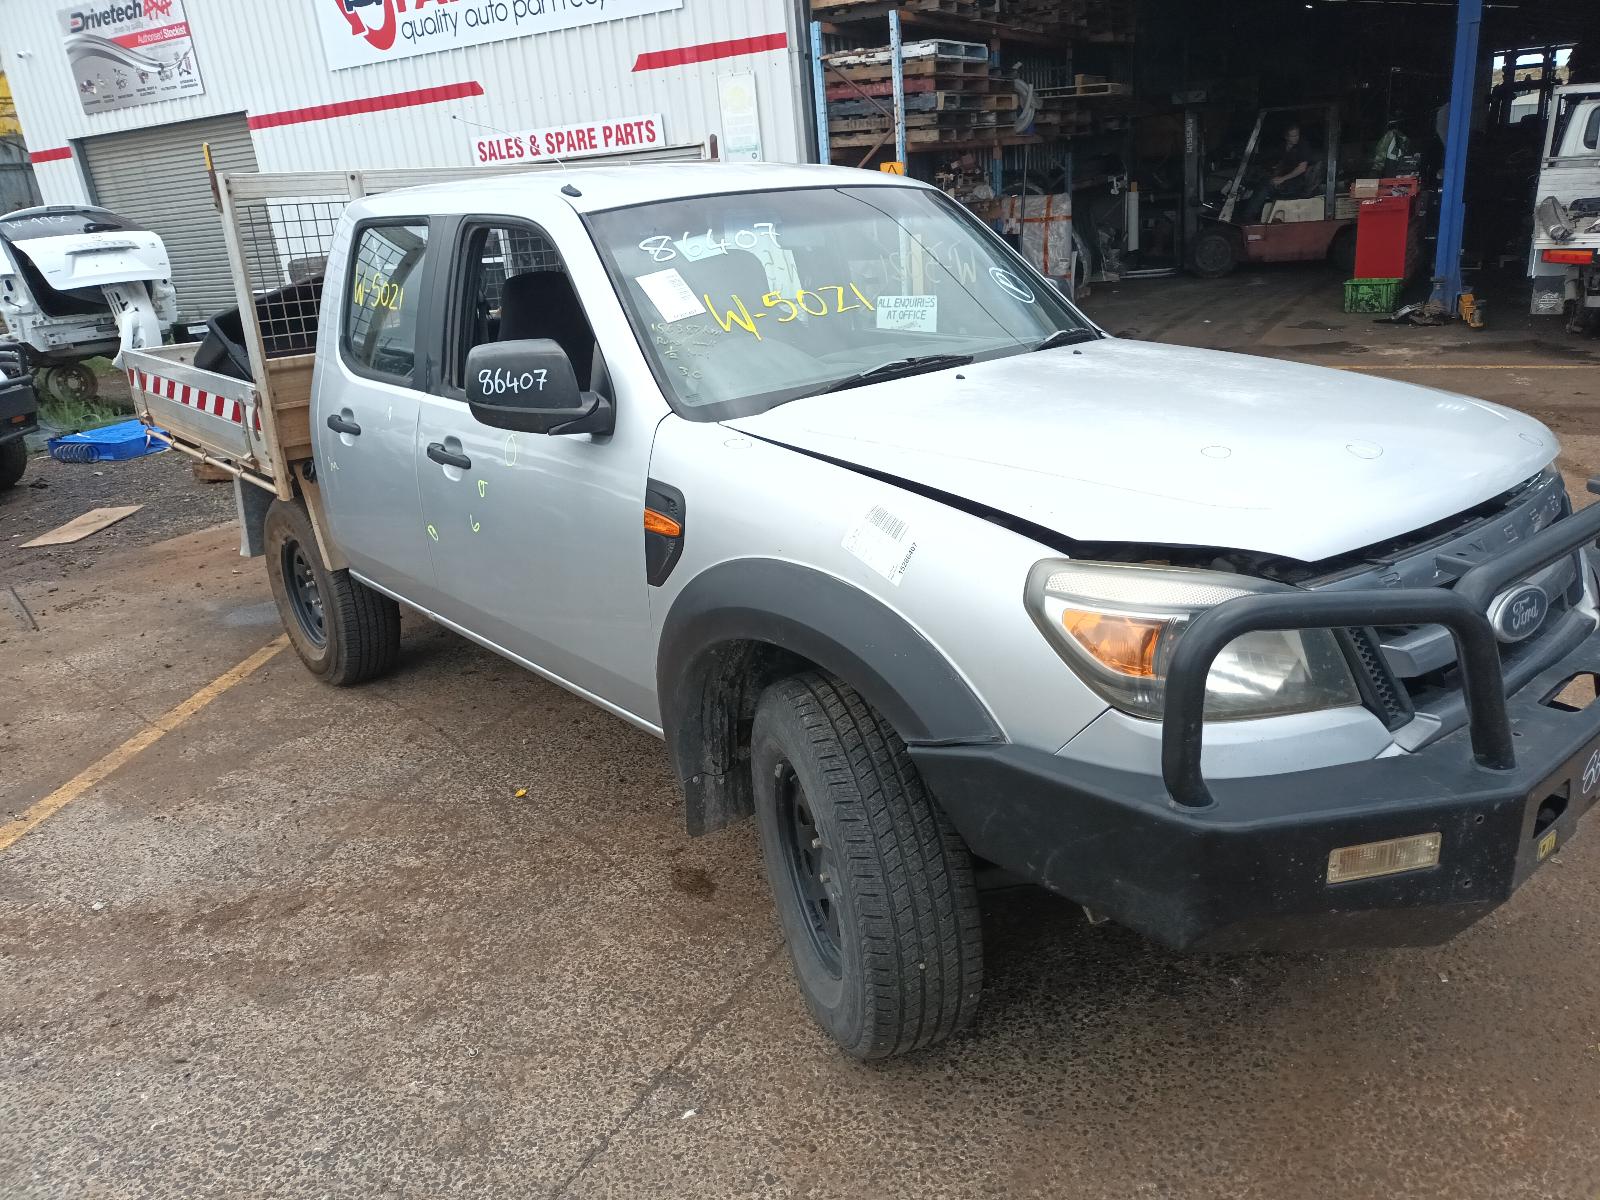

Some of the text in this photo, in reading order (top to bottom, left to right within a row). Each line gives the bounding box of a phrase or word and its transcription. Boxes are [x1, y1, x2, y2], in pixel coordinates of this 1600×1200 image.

[70, 0, 143, 33] Drivetech
[163, 24, 187, 39] Stockist
[401, 8, 459, 45] quality
[464, 0, 508, 27] auto
[477, 119, 657, 163] SALES & SPARE PARTS
[638, 222, 781, 262] 86407
[354, 263, 404, 310] W-5021
[877, 297, 936, 309] ALL ENQUIRIES
[703, 282, 875, 341] W-5021
[886, 309, 927, 320] AT OFFICE
[478, 367, 548, 396] 86407
[1512, 596, 1539, 630] Ford
